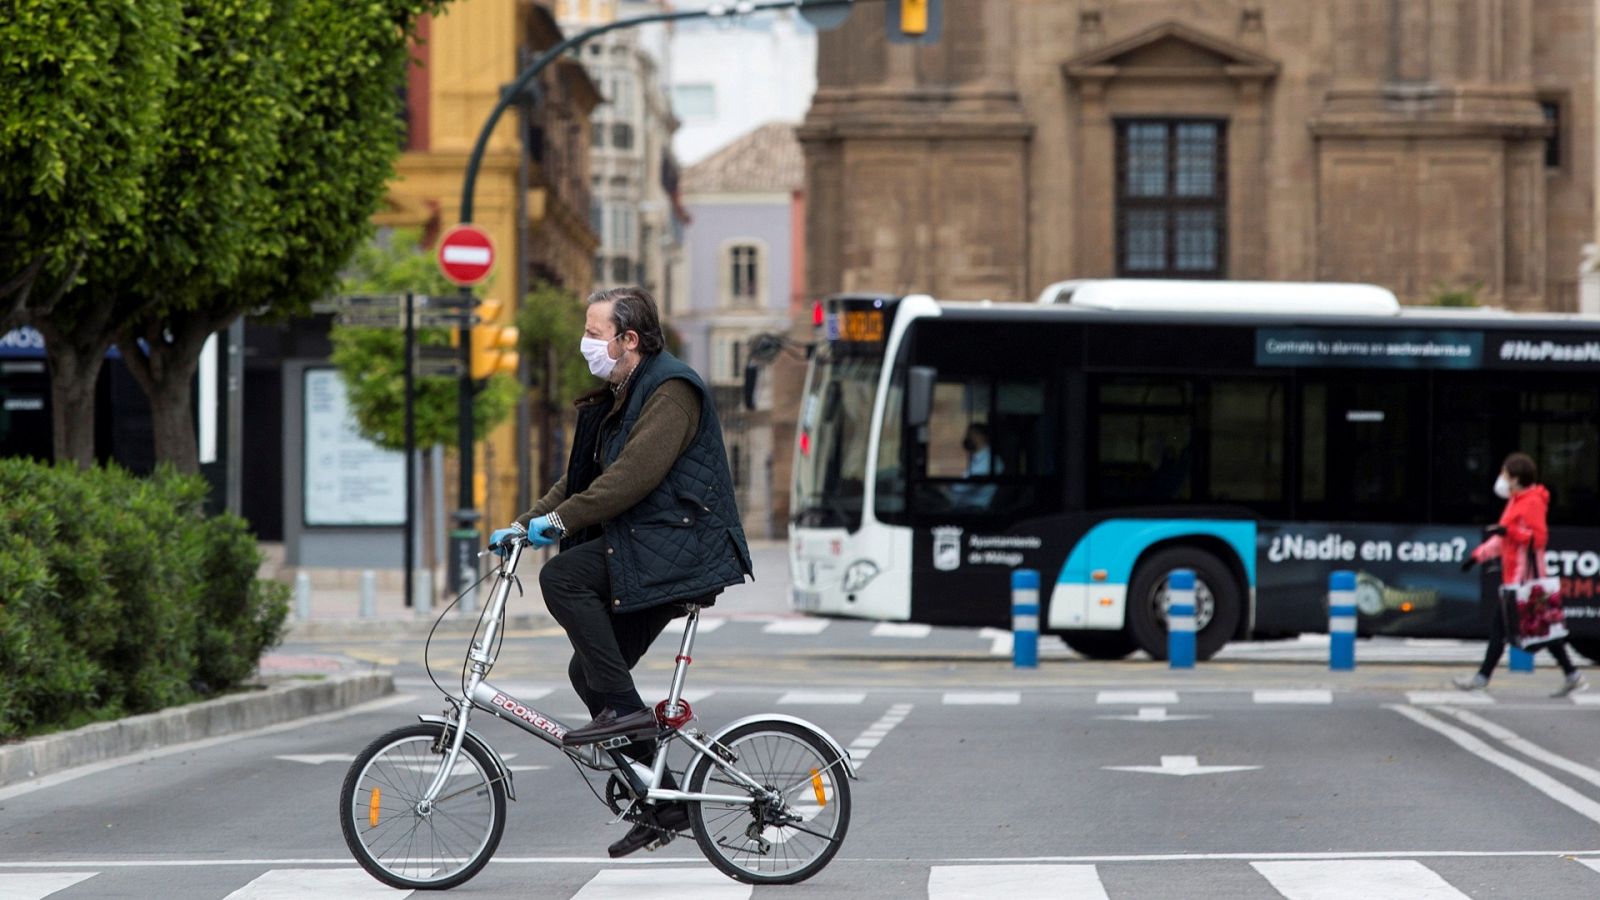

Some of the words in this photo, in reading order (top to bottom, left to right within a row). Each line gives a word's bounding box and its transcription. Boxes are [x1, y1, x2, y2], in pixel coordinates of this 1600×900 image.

[1500, 341, 1600, 361] #NoPasaN
[1268, 534, 1356, 562] ¿Nadie
[1360, 540, 1393, 561] en
[1397, 537, 1467, 562] casa?
[1543, 550, 1600, 577] CTO
